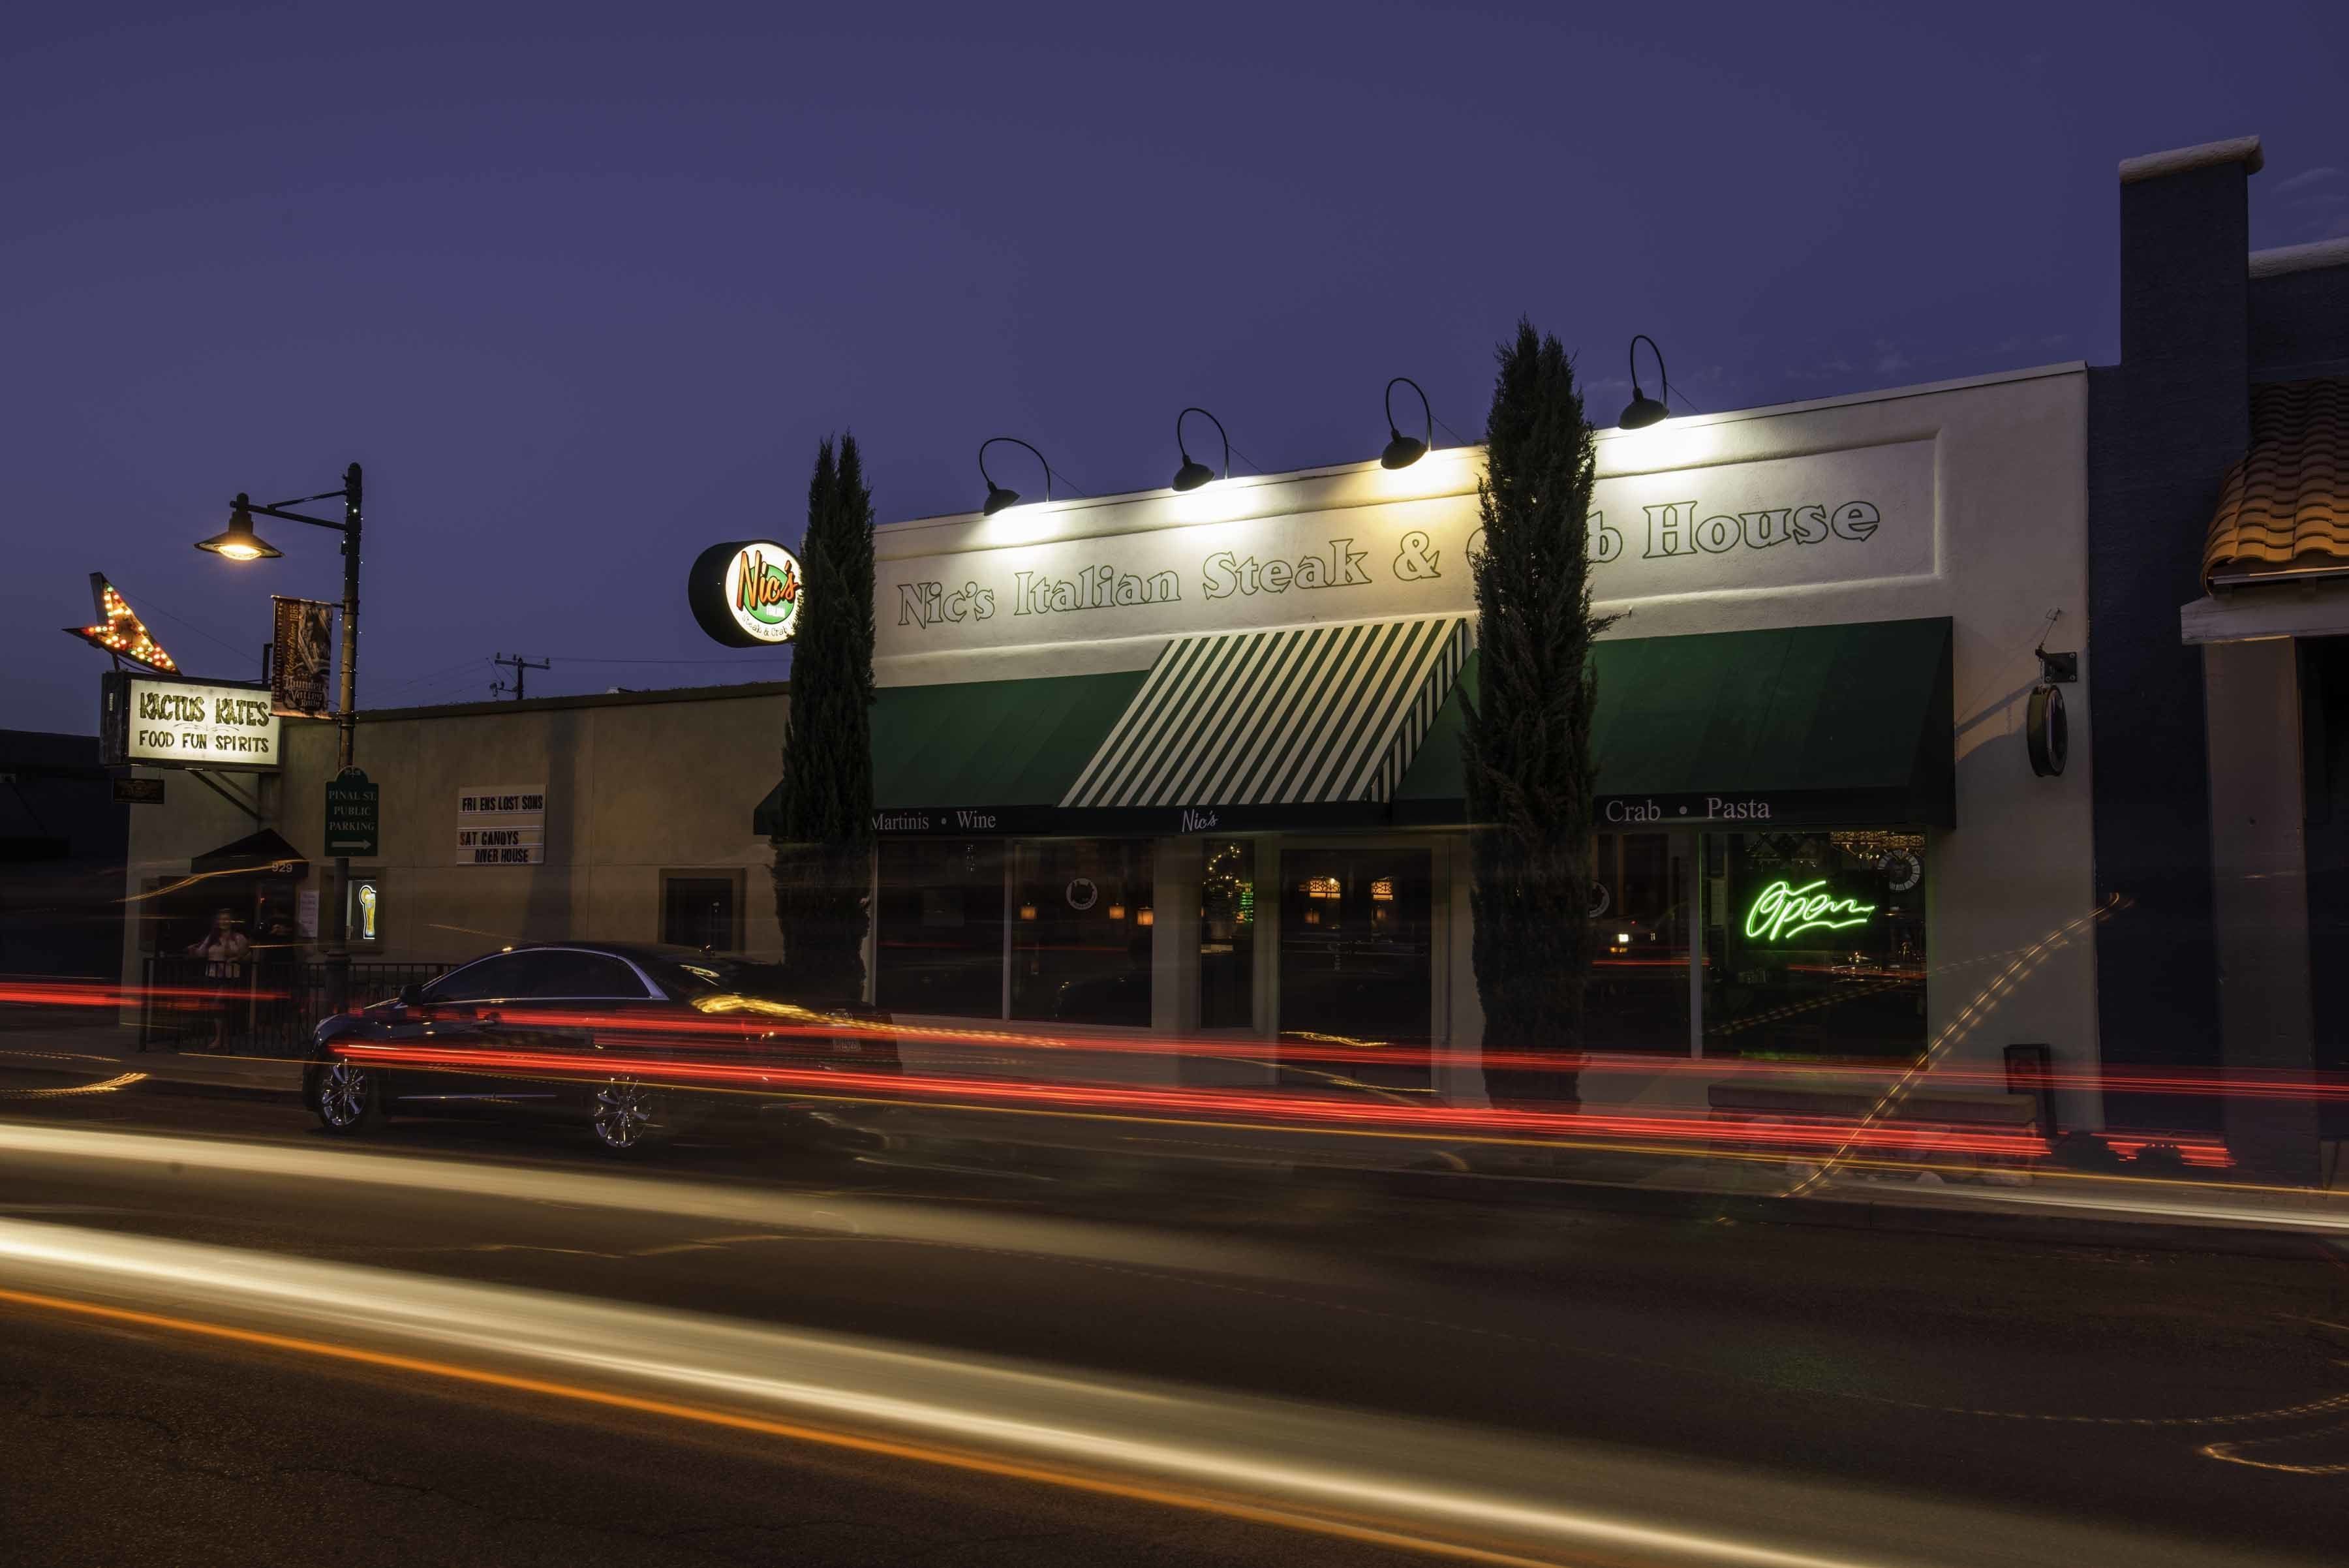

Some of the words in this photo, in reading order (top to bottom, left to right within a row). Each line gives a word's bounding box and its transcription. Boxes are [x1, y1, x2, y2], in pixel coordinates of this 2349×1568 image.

[897, 581, 995, 630] Nic's
[1014, 564, 1181, 617] Italian
[1203, 538, 1373, 599] Steak
[1394, 530, 1441, 581] &
[1643, 500, 1881, 560] House
[737, 550, 799, 611] Nic's
[140, 692, 205, 722] KACTUS
[216, 698, 269, 727] KATES
[139, 730, 175, 747] FOOD
[182, 733, 207, 749] FUN
[216, 735, 269, 753] SPIRITS
[329, 790, 360, 799] PINAL
[462, 797, 476, 811] FRI
[499, 795, 519, 810] LOST
[334, 805, 371, 816] PUBLIC
[1605, 799, 1661, 822] Crab
[1706, 797, 1771, 820] Pasta
[330, 820, 375, 831] PARKING
[872, 812, 929, 831] Martinis
[956, 810, 997, 829] Wine
[1181, 808, 1218, 833] Nic's
[459, 831, 477, 846] SAT
[501, 848, 529, 863] HOUSE
[271, 862, 292, 872] 929
[1746, 881, 1876, 940] Open
